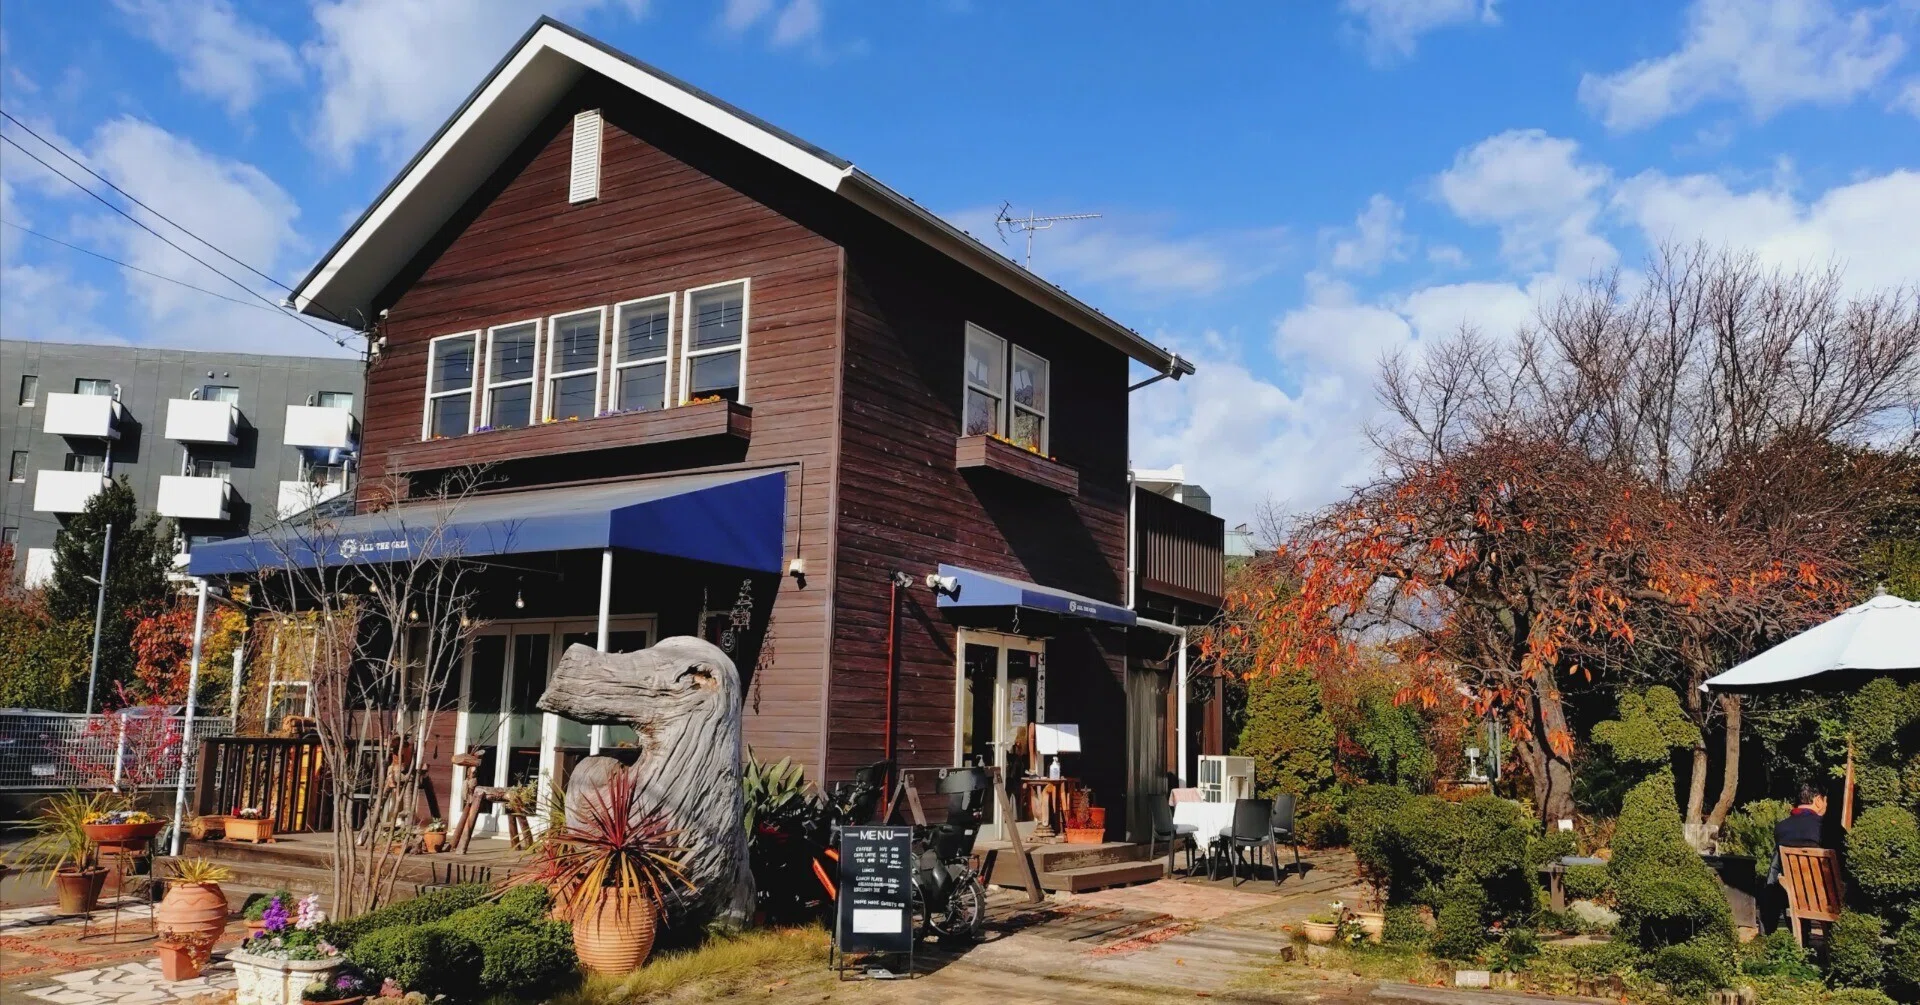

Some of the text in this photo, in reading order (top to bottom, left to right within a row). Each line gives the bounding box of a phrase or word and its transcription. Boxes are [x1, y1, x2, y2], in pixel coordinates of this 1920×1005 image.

[360, 544, 374, 552] ALL
[376, 542, 390, 550] THE
[860, 830, 894, 840] MENU
